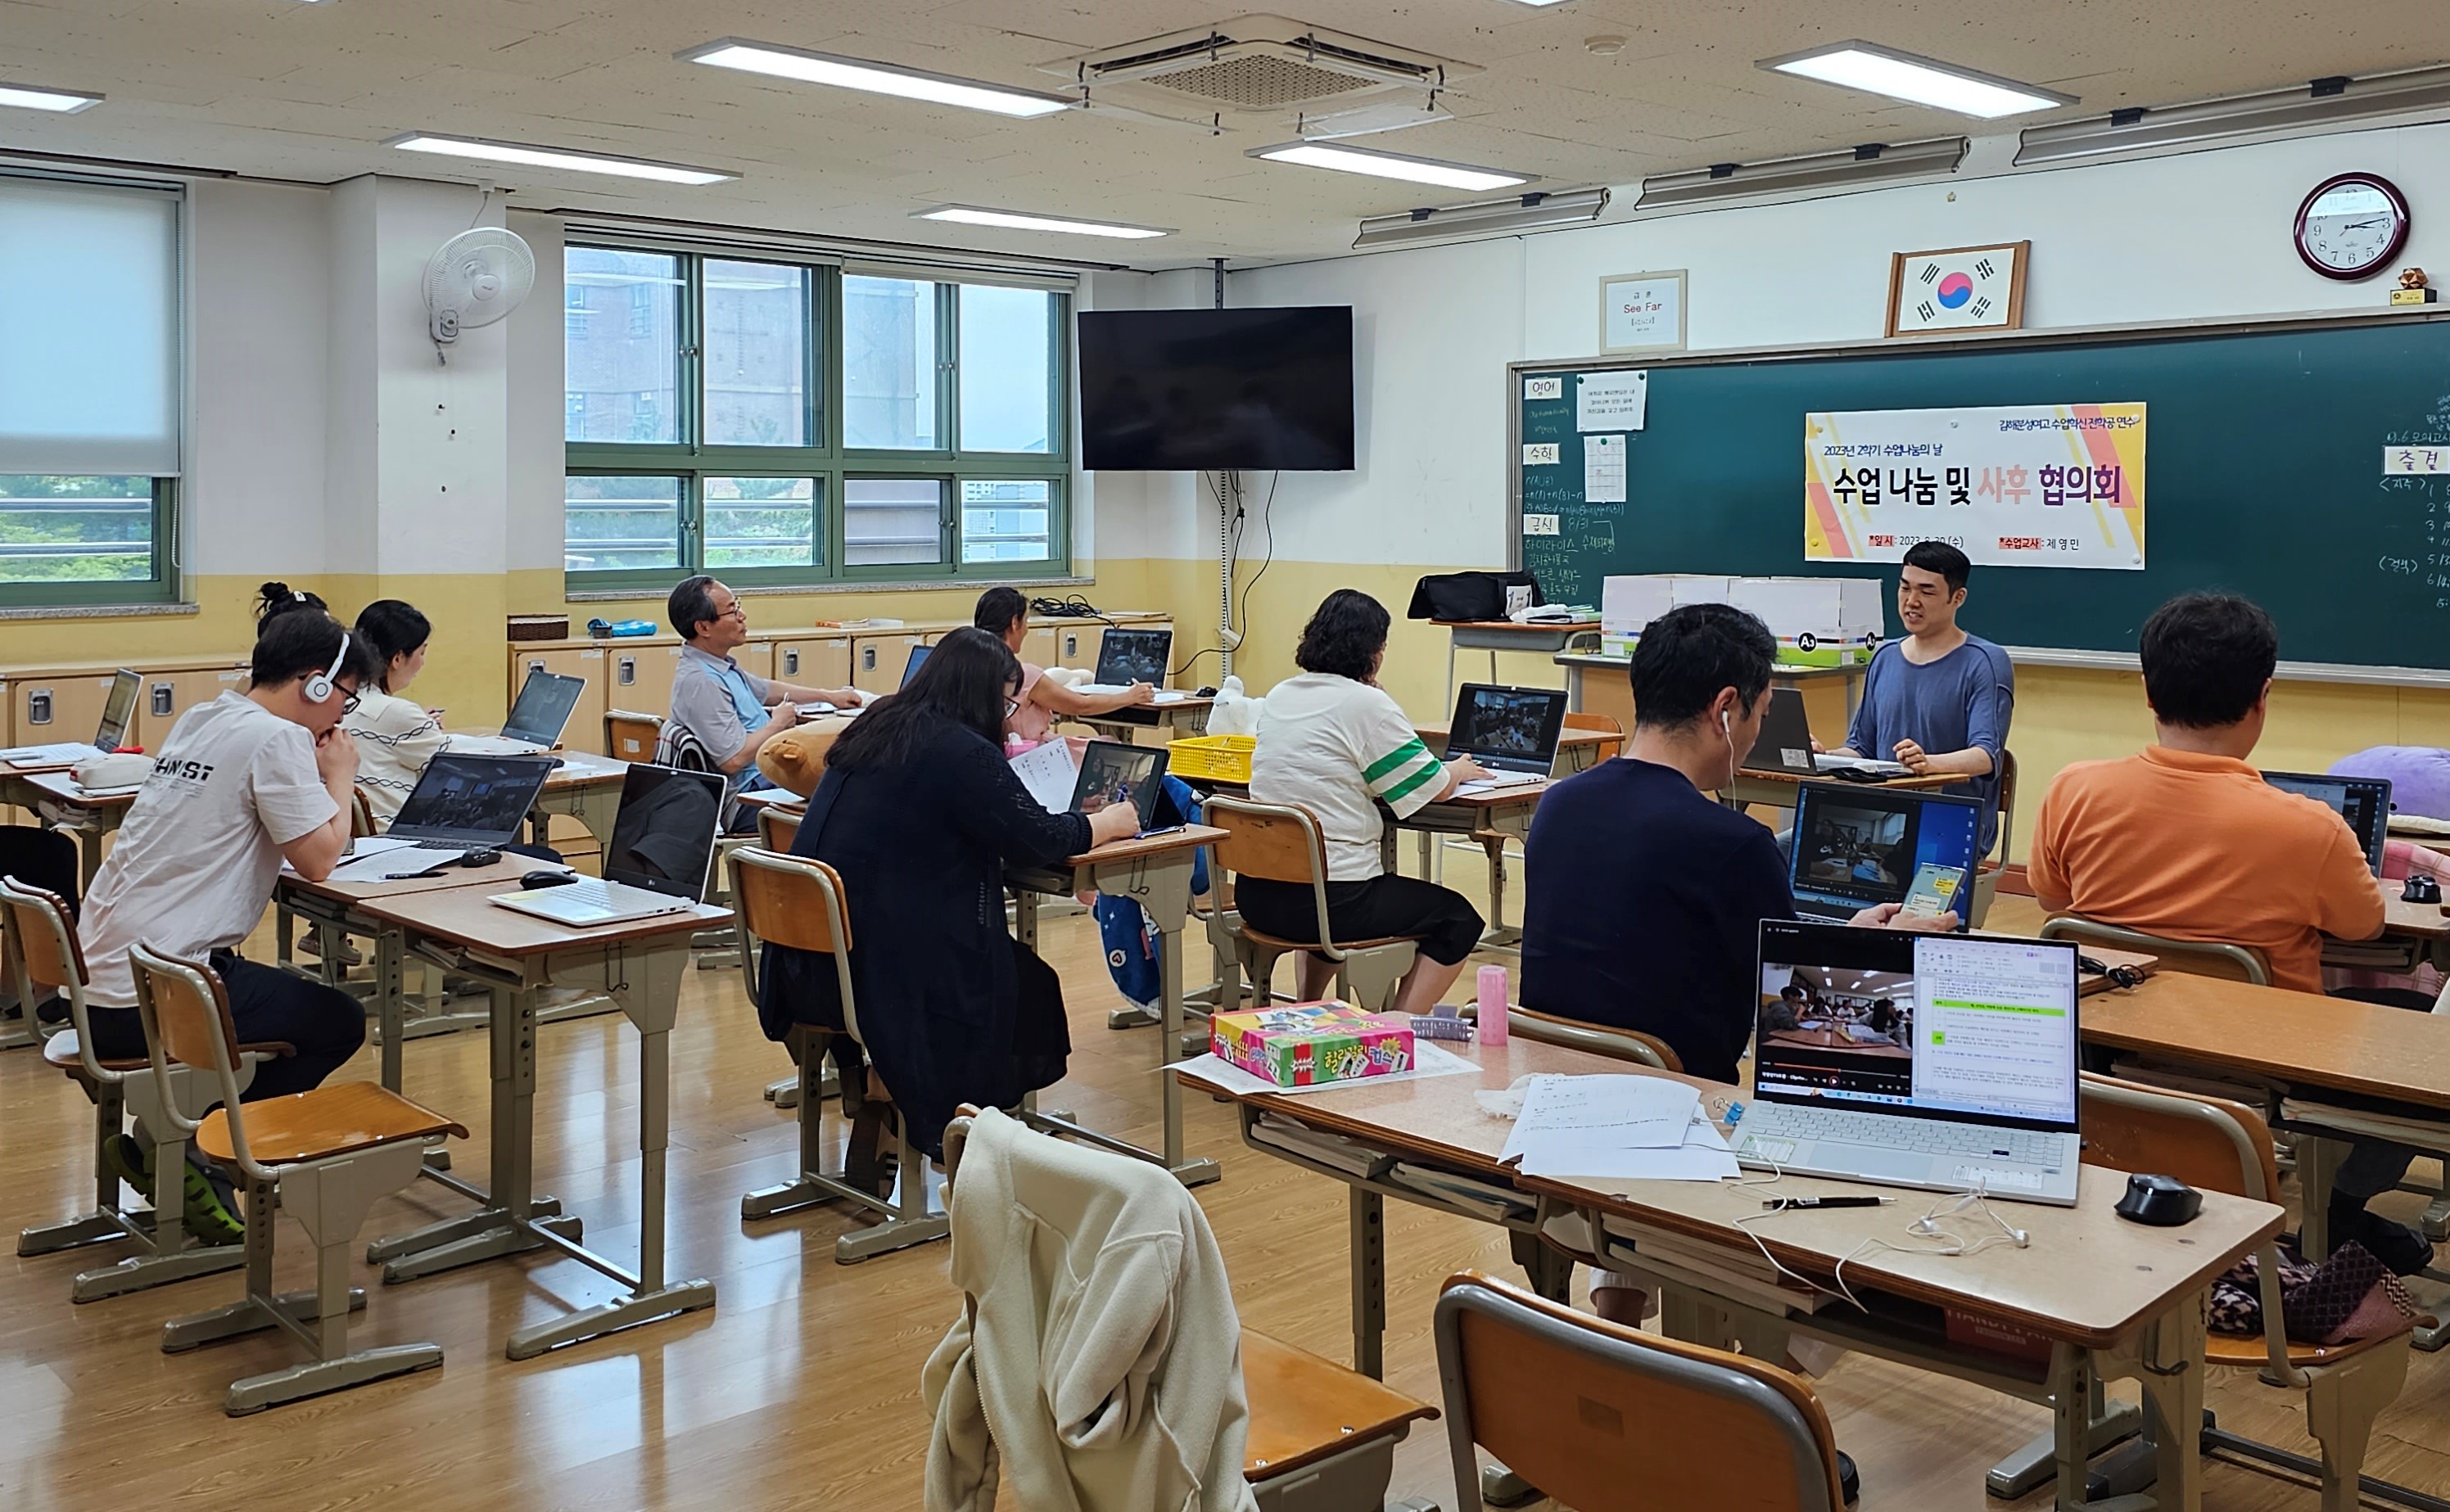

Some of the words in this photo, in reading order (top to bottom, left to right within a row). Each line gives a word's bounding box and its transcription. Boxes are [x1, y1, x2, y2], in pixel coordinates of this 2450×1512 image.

[2382, 218, 2391, 229] 3
[2313, 224, 2322, 237] 9
[2375, 233, 2385, 245] 4
[2318, 241, 2327, 252] 8
[2330, 250, 2339, 262] 7
[2348, 253, 2357, 264] 6
[2366, 247, 2375, 259] 5
[1624, 304, 1641, 314] See
[1645, 301, 1662, 312] Far
[1532, 381, 1555, 396] 영어
[1999, 418, 2050, 431] 김해분성여고
[2052, 417, 2087, 430] 수업혁신
[2117, 415, 2136, 427] 연수
[1530, 446, 1553, 461] 수학
[1824, 445, 1856, 457] 2023년
[1857, 444, 1881, 457] 2학기
[1883, 443, 1930, 457] 수업나눔의
[1932, 442, 1943, 456] 날
[1833, 467, 1881, 505] 수업
[1889, 467, 1939, 506] 나눔
[1946, 467, 1972, 506] 및
[1977, 463, 2031, 505] 사후
[2038, 463, 2121, 507] 협의회
[2426, 503, 2436, 513] 2
[1530, 517, 1553, 532] 급식
[2425, 519, 2435, 530] 3
[1801, 636, 1815, 648] A3
